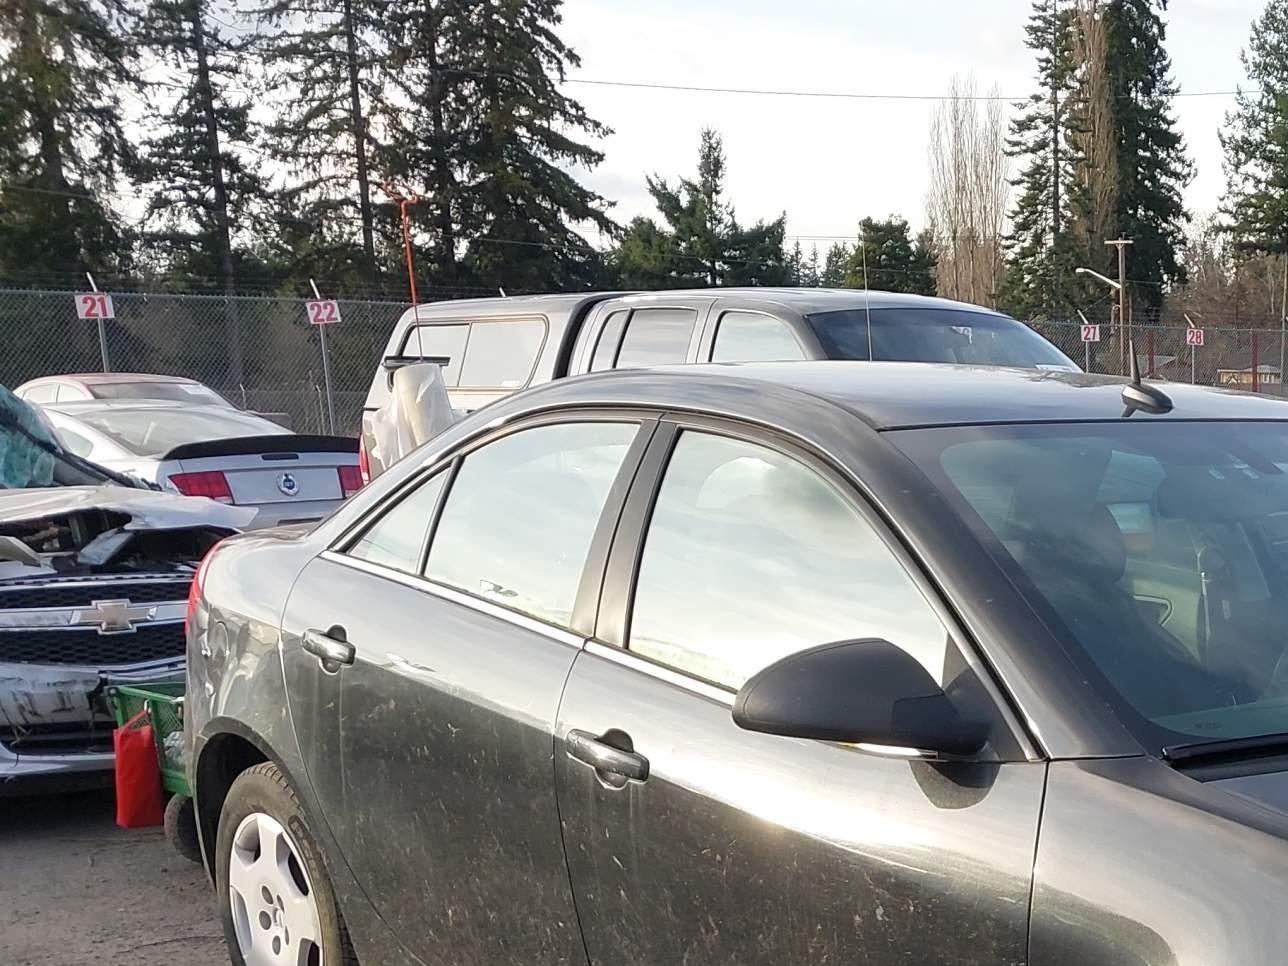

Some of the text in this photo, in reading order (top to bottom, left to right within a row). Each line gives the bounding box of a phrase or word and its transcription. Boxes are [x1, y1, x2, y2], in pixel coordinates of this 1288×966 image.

[81, 295, 108, 317] 21
[310, 302, 337, 322] 22
[1083, 326, 1096, 340] 27
[1188, 330, 1202, 345] 28
